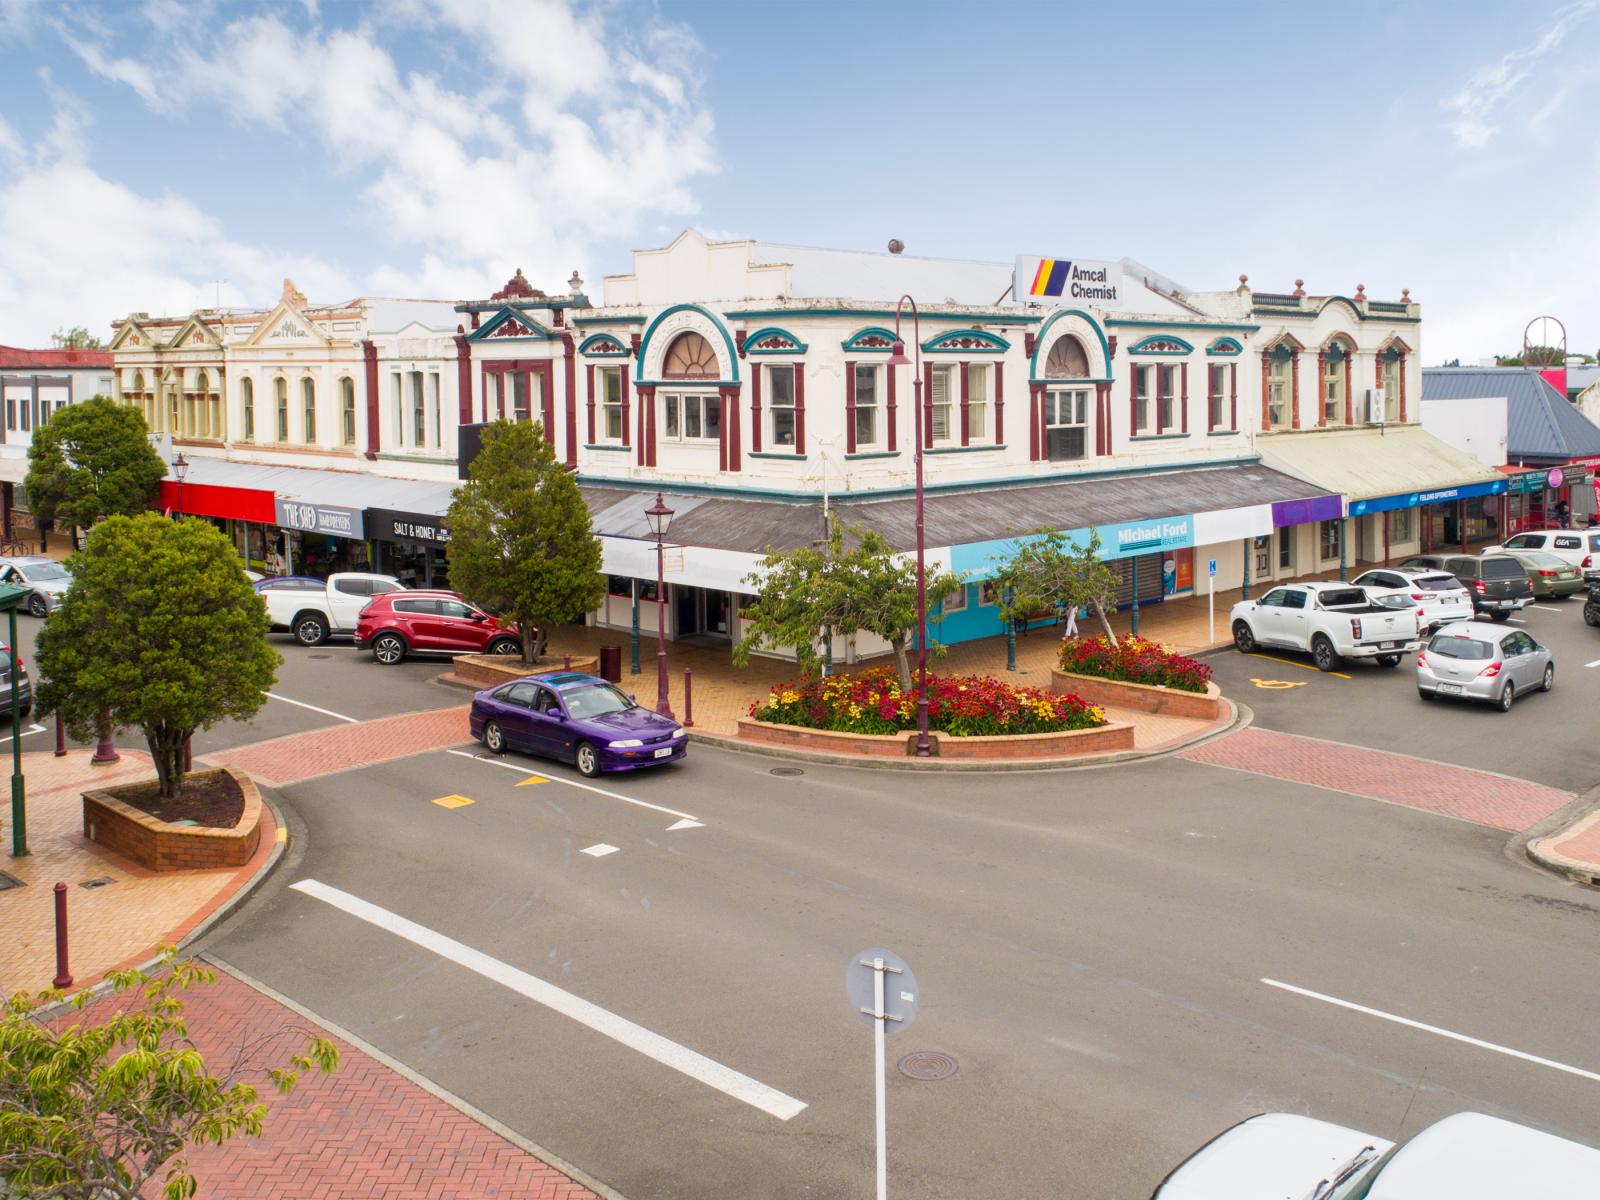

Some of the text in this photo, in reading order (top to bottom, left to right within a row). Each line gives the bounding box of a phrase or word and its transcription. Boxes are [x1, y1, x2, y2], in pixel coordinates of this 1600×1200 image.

[1072, 265, 1106, 282] Amcal
[1071, 282, 1116, 299] Chemist
[283, 503, 316, 529] THE SHED
[394, 522, 408, 536] SALT
[409, 524, 414, 536] &
[415, 526, 435, 540] HONEY
[1118, 521, 1187, 543] Michael Ford
